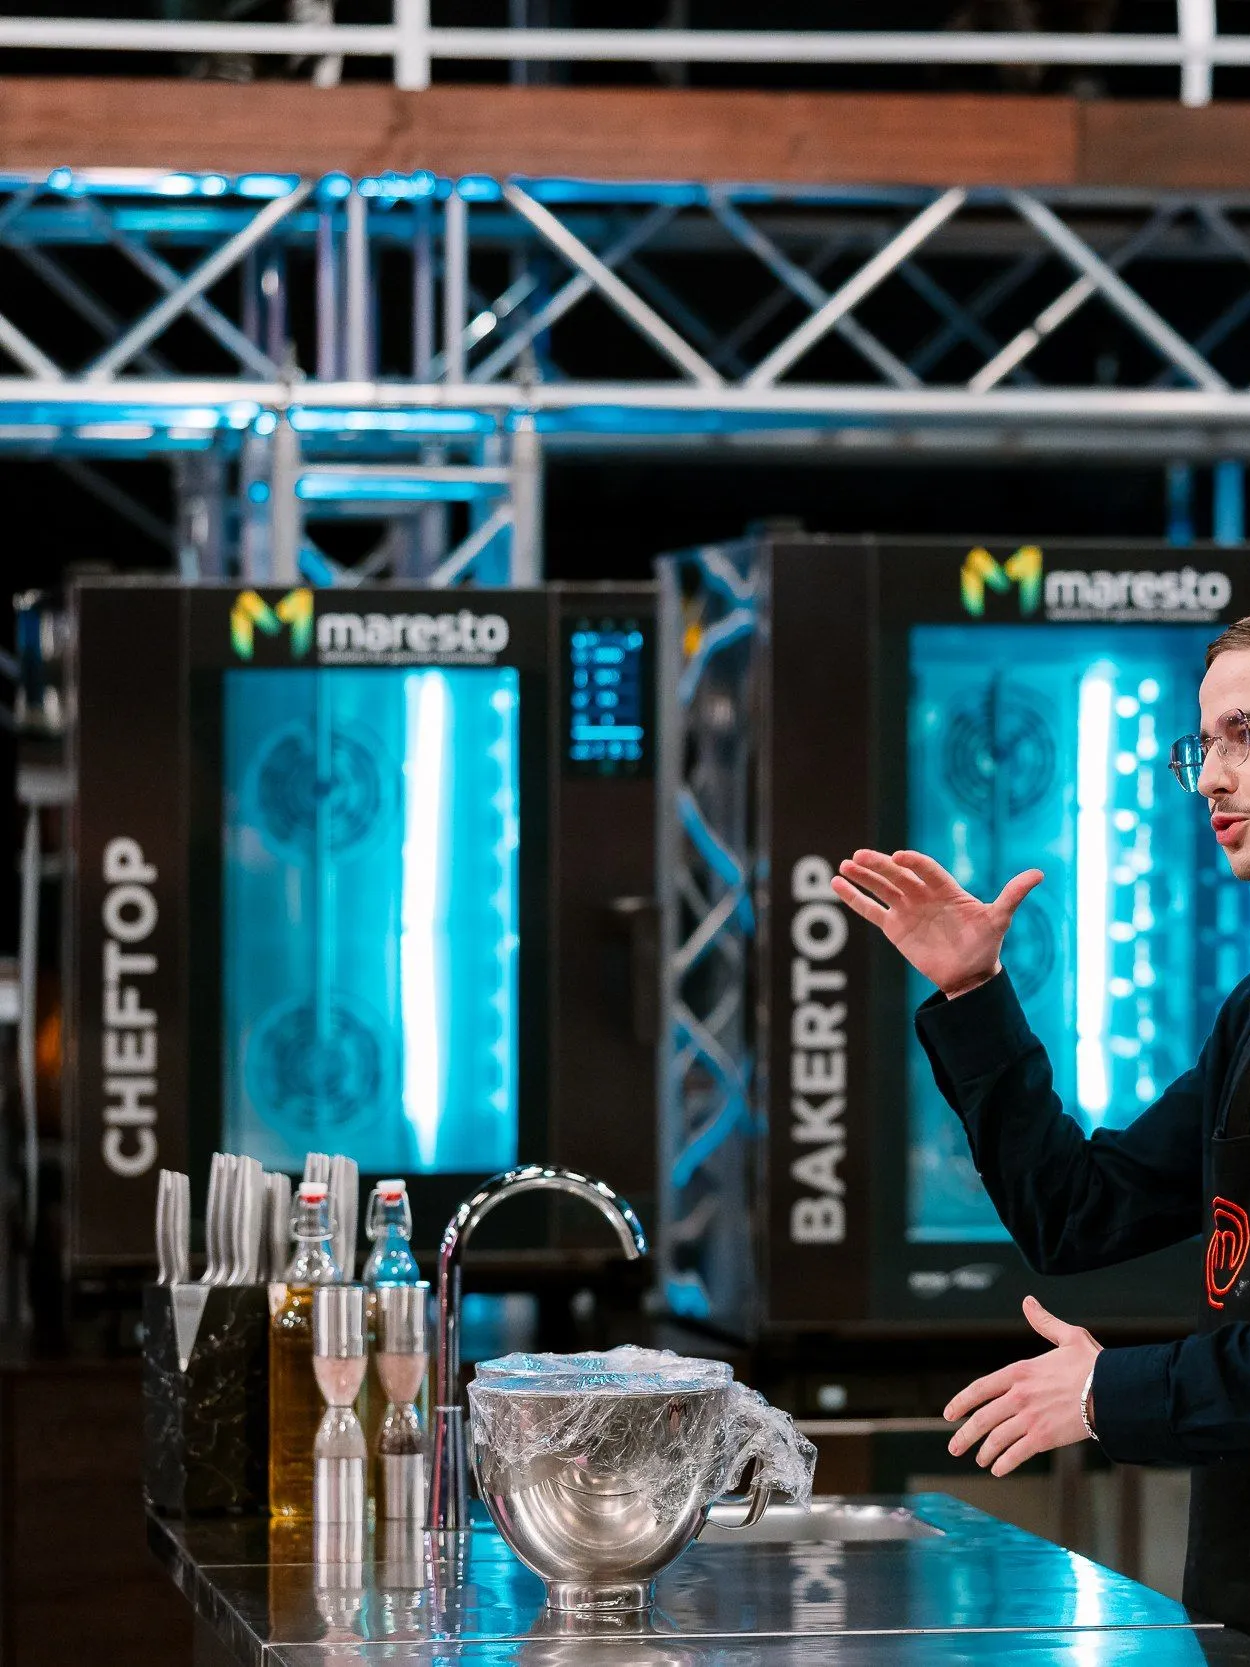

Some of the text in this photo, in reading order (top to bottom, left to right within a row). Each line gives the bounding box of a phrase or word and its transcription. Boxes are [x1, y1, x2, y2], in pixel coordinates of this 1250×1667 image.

[317, 609, 509, 652] maresto
[1045, 566, 1231, 610] maresto
[103, 836, 158, 1177] CHEFTOP
[791, 855, 848, 1244] BAKERTOP
